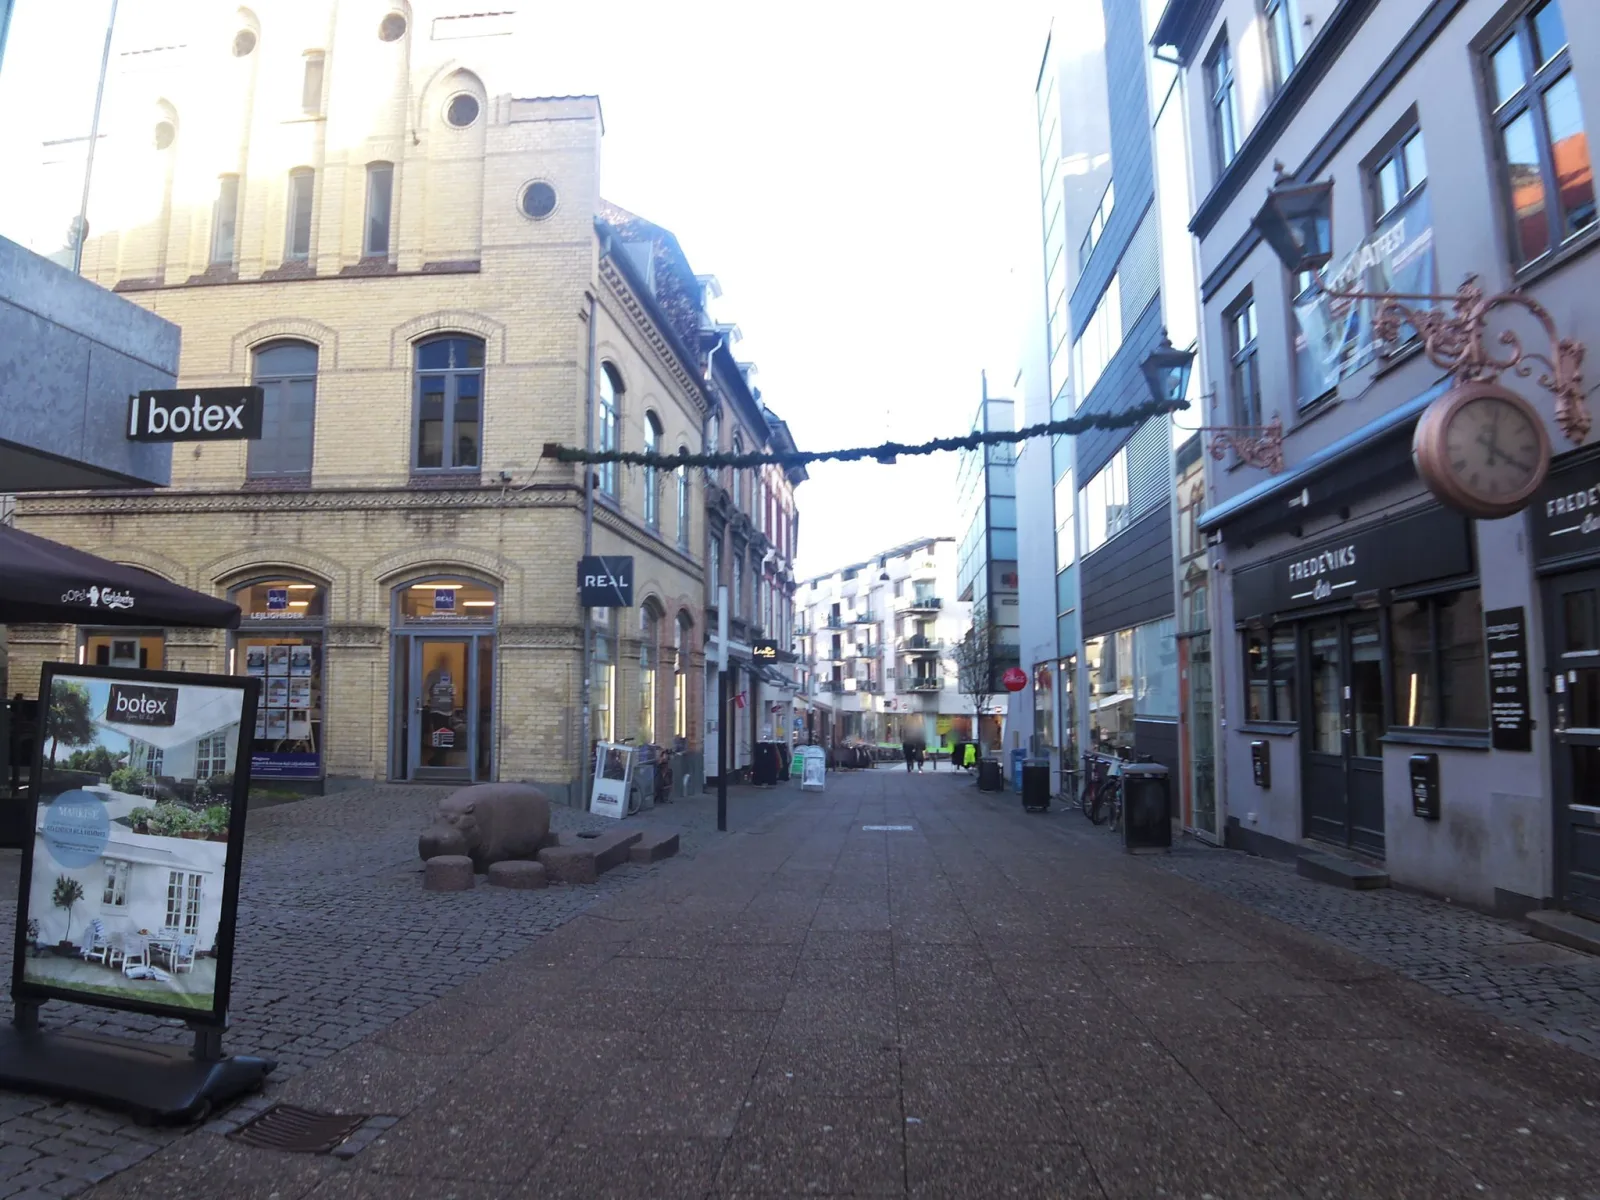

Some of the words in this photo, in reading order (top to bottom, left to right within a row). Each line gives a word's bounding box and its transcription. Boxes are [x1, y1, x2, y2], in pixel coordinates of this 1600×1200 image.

[147, 394, 244, 434] botex
[1546, 483, 1600, 518] FREDE
[584, 575, 629, 587] REAL
[1288, 545, 1357, 582] FREDERIKS
[116, 691, 167, 714] botex
